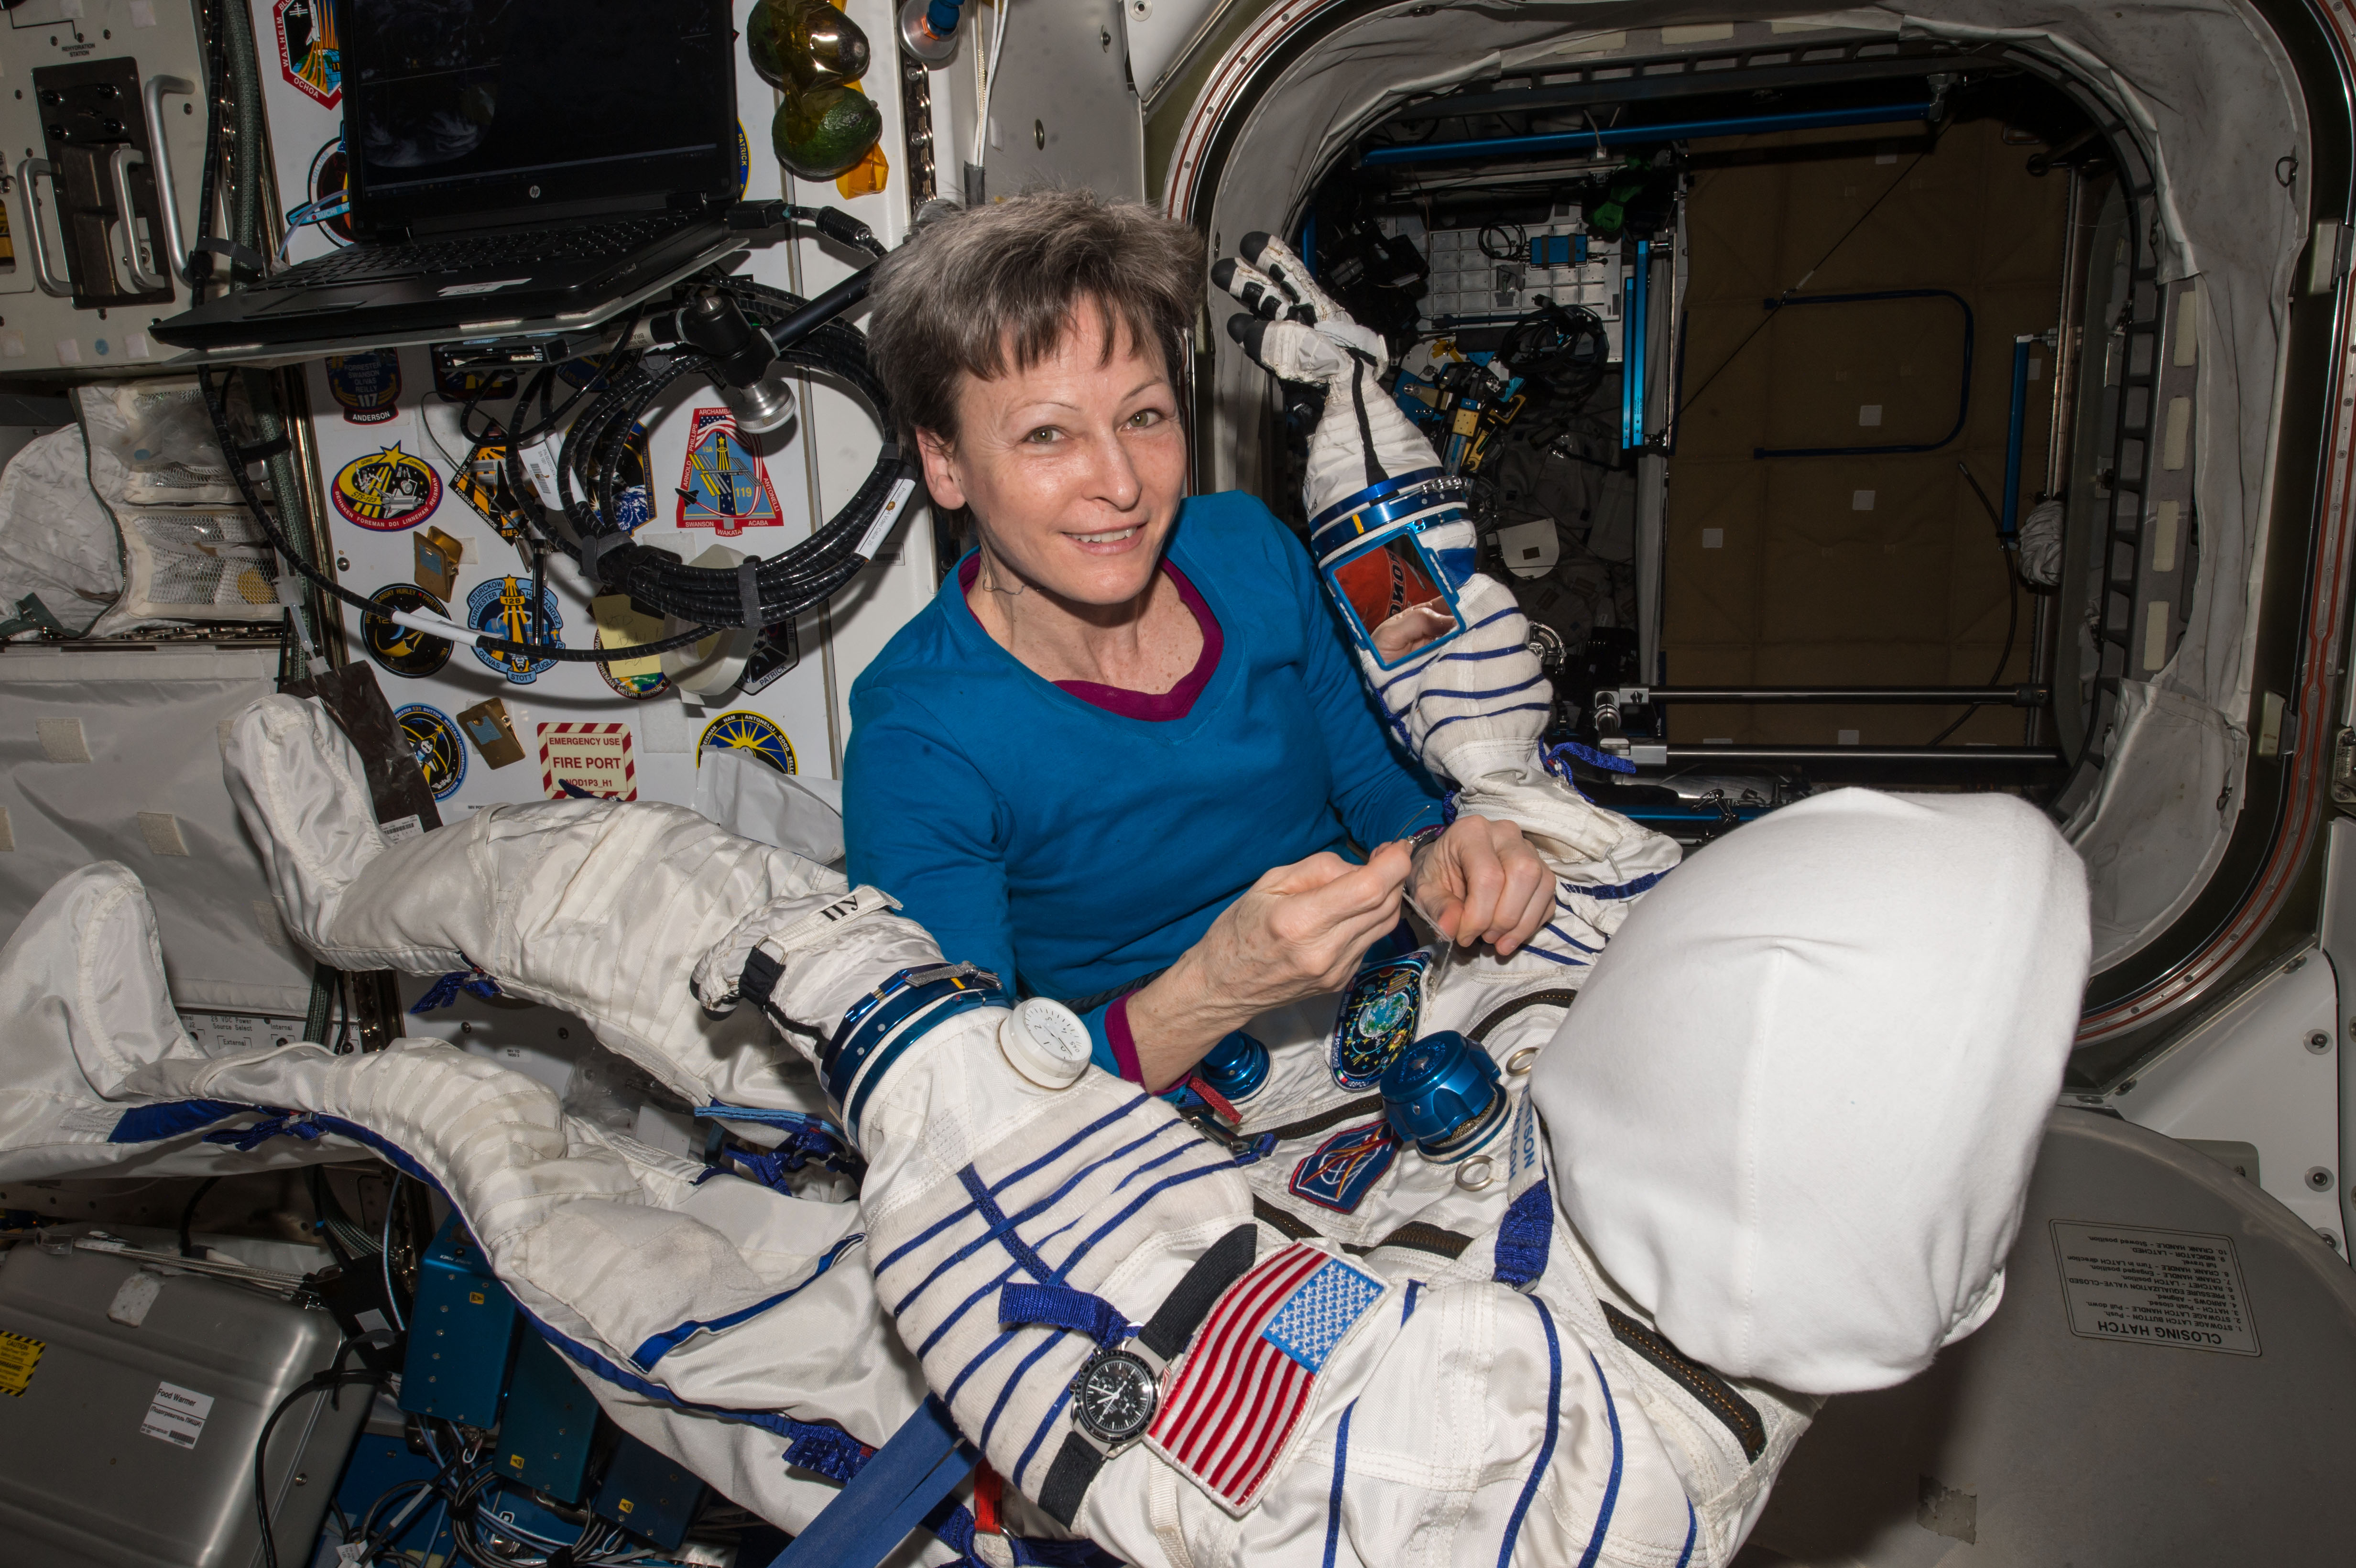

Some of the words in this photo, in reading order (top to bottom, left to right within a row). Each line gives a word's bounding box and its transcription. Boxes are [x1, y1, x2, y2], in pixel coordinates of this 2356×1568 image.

[61, 43, 96, 52] REHYDRATION
[276, 17, 289, 67] WALHEIM
[294, 77, 319, 98] OCHOA
[738, 133, 747, 166] PATRICK
[311, 151, 329, 184] COLLINS
[529, 185, 540, 198] hp
[344, 362, 382, 371] FORRESTER
[348, 370, 380, 378] SWANSON
[354, 377, 377, 385] OLIVAS
[357, 392, 379, 407] 117
[352, 411, 391, 422] ANDERSON
[688, 423, 698, 452] PHILLIPS
[467, 447, 479, 464] KELLY
[407, 458, 427, 472] JOHNSON
[683, 460, 692, 487] ARNOLD
[351, 491, 377, 503] STS-123
[735, 487, 753, 497] 119
[763, 478, 780, 512] ANTONELLI
[335, 491, 354, 518] BEHNKEN
[357, 516, 385, 527] FOREMAN
[403, 507, 429, 524] LINNEHAN
[429, 478, 439, 506] REISMAN
[455, 487, 476, 508] FOSSUM
[476, 508, 498, 529] HOSHIDE
[881, 516, 891, 528] Video
[501, 529, 519, 537] きぼう
[871, 527, 882, 540] Cable
[469, 581, 503, 603] STURCKOW
[396, 588, 416, 597] HURLEY
[422, 594, 443, 613] PAYETTE
[470, 591, 498, 626] FORRESTER
[479, 650, 501, 669] OLIVAS
[598, 662, 616, 688] OREMAN
[617, 687, 638, 698] MELVIN
[641, 685, 664, 697] BRESNIK
[759, 664, 786, 686] PATRICK
[423, 707, 442, 718] DUTTON
[723, 715, 736, 723] HAM
[744, 714, 775, 732] ANTONELLI
[778, 735, 790, 751] GOOD
[549, 738, 601, 746] EMERGENCY
[603, 738, 621, 746] USE
[444, 719, 466, 779] METCALF-LINDENBURGER
[553, 757, 582, 769] FIRE
[585, 757, 622, 769] PORT
[566, 779, 612, 787] NOD1P3_H1
[437, 781, 458, 797] ANDERSON
[223, 1038, 247, 1046] External
[2120, 1239, 2148, 1247] Stowed
[2156, 1242, 2186, 1251] HANDLE
[2130, 1247, 2167, 1256] LATCHED.
[2187, 1246, 2214, 1254] CRANK
[2067, 1255, 2098, 1263] direction
[2175, 1252, 2216, 1261] INDICATOR
[2123, 1268, 2155, 1277] Engaged
[2160, 1264, 2191, 1273] HANDLE
[2193, 1268, 2219, 1276] CRANK
[2154, 1278, 2180, 1286] LATCH
[2163, 1272, 2193, 1281] HANDLE
[2195, 1275, 2221, 1284] CRANK
[2067, 1277, 2128, 1289] VALVE-CLOSED.
[2189, 1282, 2224, 1292] RATCHET
[2130, 1284, 2185, 1295] EQUALIZATION
[2186, 1289, 2225, 1299] PRESSURE
[2155, 1294, 2184, 1302] Aligned.
[2193, 1298, 2226, 1307] ARROWS
[2131, 1306, 2162, 1315] HANDLE
[2164, 1309, 2190, 1318] LATCH
[2203, 1307, 2229, 1315] HATCH
[2132, 1314, 2164, 1323] BUTTON
[2166, 1318, 2192, 1326] LATCH
[2192, 1313, 2231, 1323] STOWAGE
[2097, 1320, 2150, 1336] HATCH
[2194, 1320, 2233, 1331] STOWAGE
[2154, 1327, 2222, 1345] CLOSING
[7, 1339, 29, 1350] CAUTION
[157, 1388, 173, 1399] Food
[174, 1393, 196, 1406] Warmer
